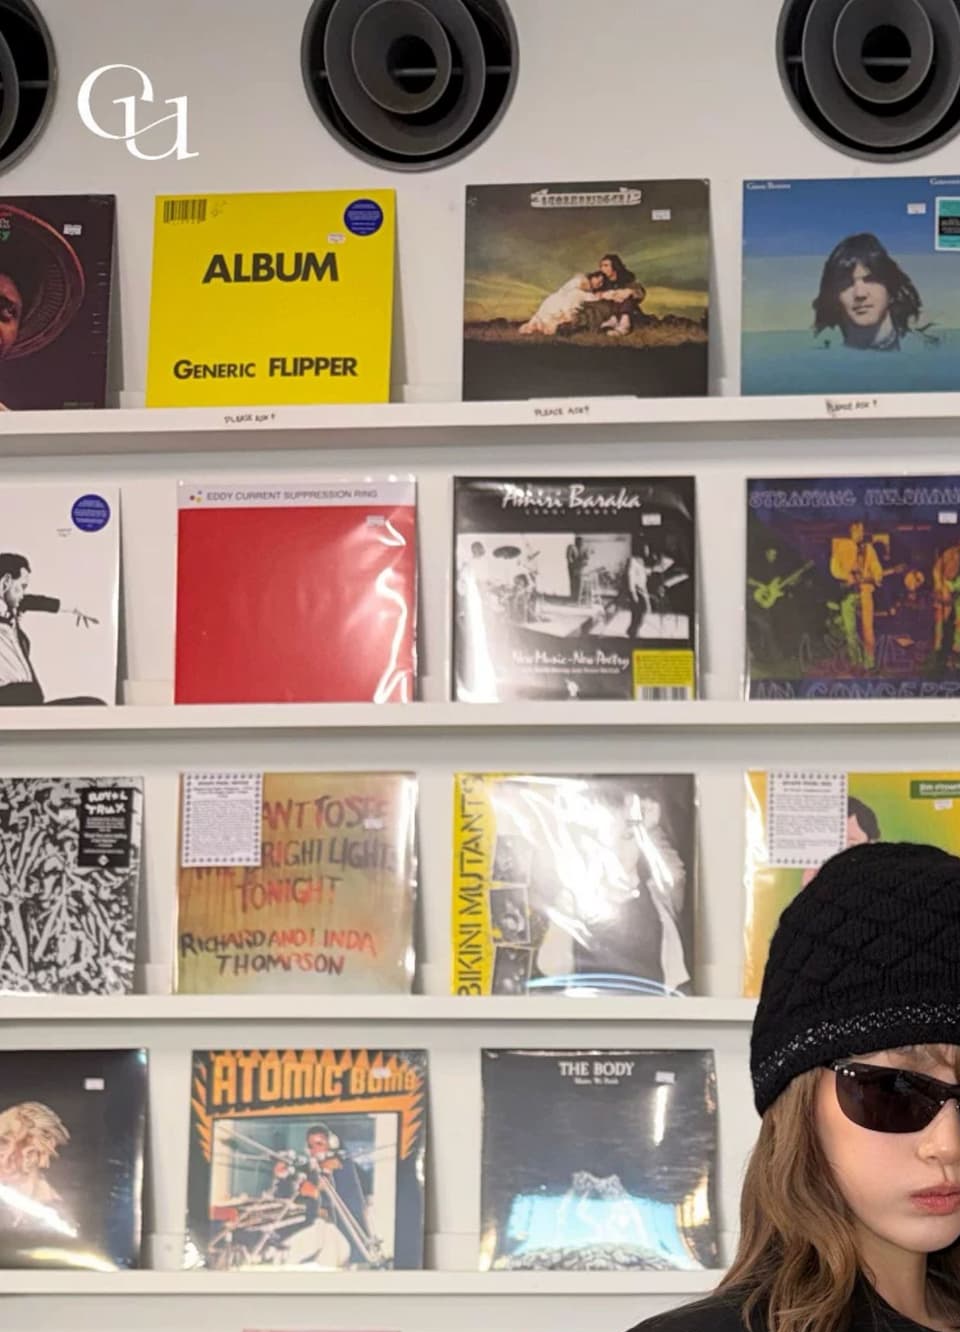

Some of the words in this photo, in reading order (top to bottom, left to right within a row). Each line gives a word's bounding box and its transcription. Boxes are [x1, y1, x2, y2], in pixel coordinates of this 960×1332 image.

[202, 252, 339, 283] ALBUM
[269, 356, 358, 379] FLIPPER
[207, 491, 232, 501] EDDY
[235, 490, 281, 500] CURRENT
[284, 489, 351, 500] SUPPRESSION
[353, 489, 378, 499] RING
[567, 484, 641, 508] Baraka
[237, 877, 344, 912] TONIGHT
[180, 931, 267, 957] RICHARD
[457, 914, 484, 997] BIKINI
[217, 952, 345, 977] THOMPSON
[213, 1054, 345, 1106] ATOMIC
[558, 1061, 590, 1076] THE
[593, 1061, 635, 1076] BODY
